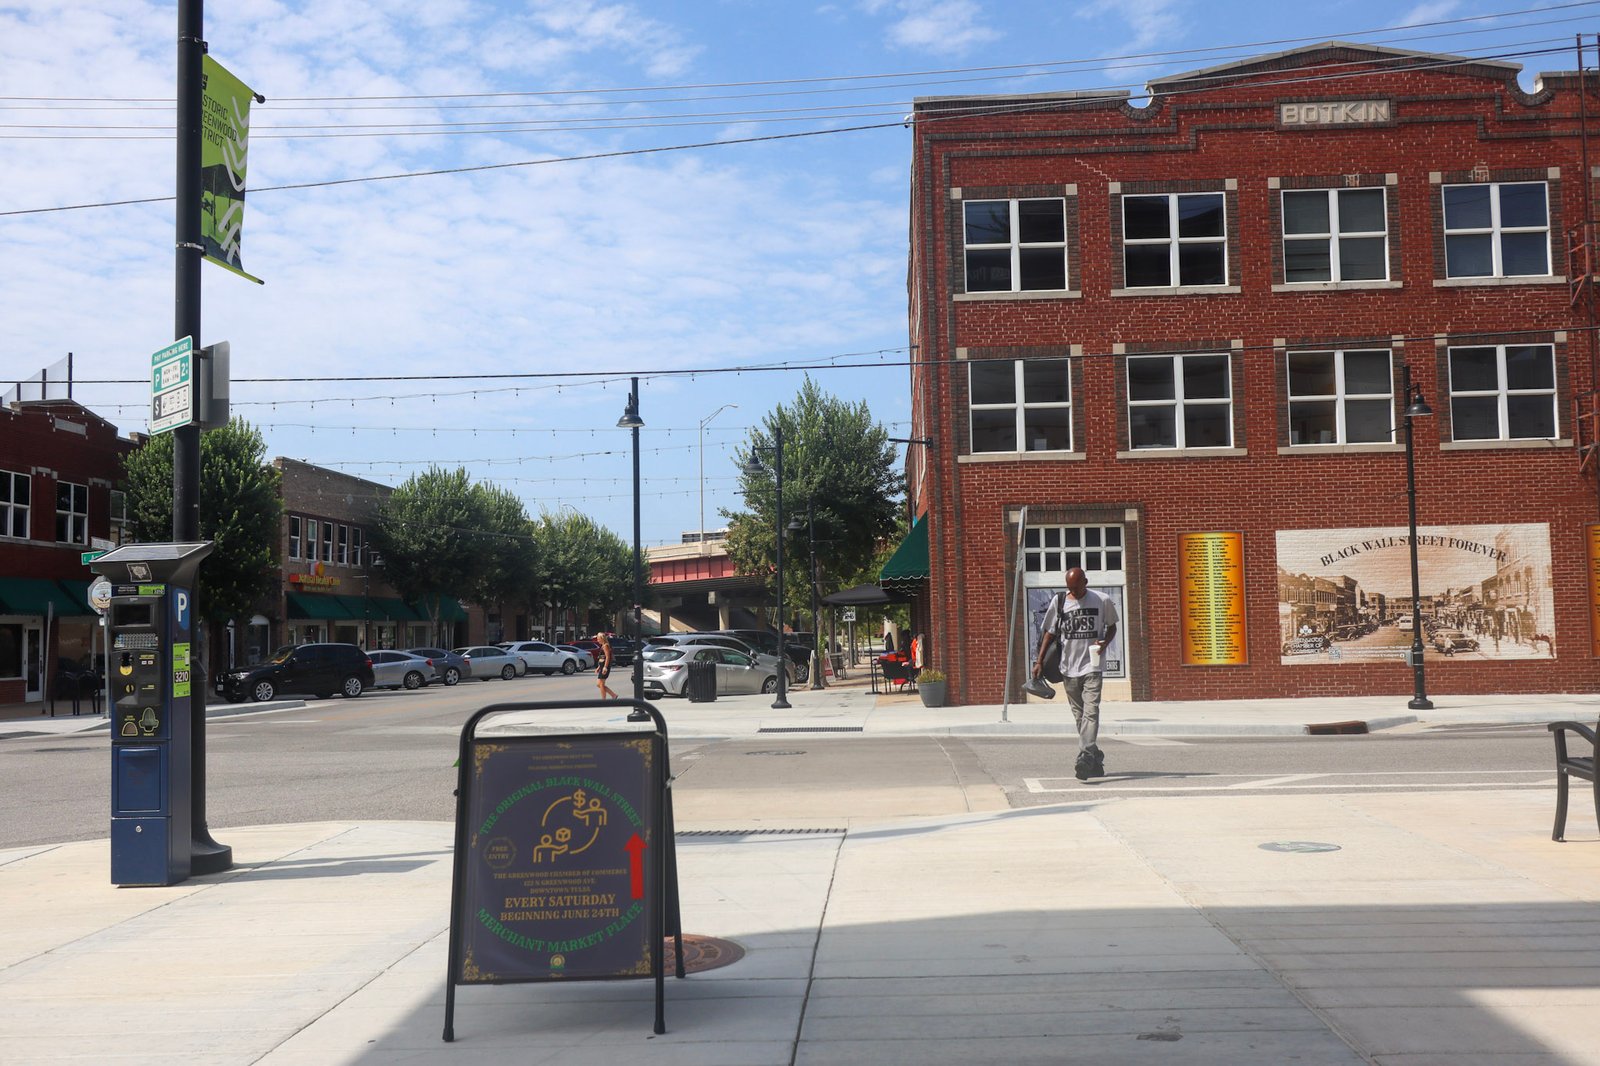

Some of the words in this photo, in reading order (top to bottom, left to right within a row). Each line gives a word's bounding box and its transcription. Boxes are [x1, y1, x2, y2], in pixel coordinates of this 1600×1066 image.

[202, 94, 229, 121] STORIC
[1282, 102, 1388, 123] BOTKIN
[202, 110, 237, 141] EENWOOD
[203, 126, 224, 148] TRICT
[1320, 544, 1360, 567] BLACK
[1362, 536, 1397, 551] WALL
[1449, 537, 1507, 563] FOREVER
[177, 593, 188, 622] P
[175, 671, 189, 683] 3210
[479, 813, 499, 834] THE
[496, 781, 544, 815] ORIGINAL
[545, 776, 581, 787] BLACK
[583, 778, 611, 797] WALL
[611, 792, 643, 828] STREET
[500, 911, 560, 921] BEGINNING
[561, 909, 590, 920] JUNE
[591, 908, 620, 918] 24TH
[505, 896, 547, 909] EVERY
[549, 894, 616, 908] SATURDAY
[476, 908, 545, 952] MERCHANT
[547, 930, 605, 953] MARKET
[605, 902, 644, 937] PLACE
